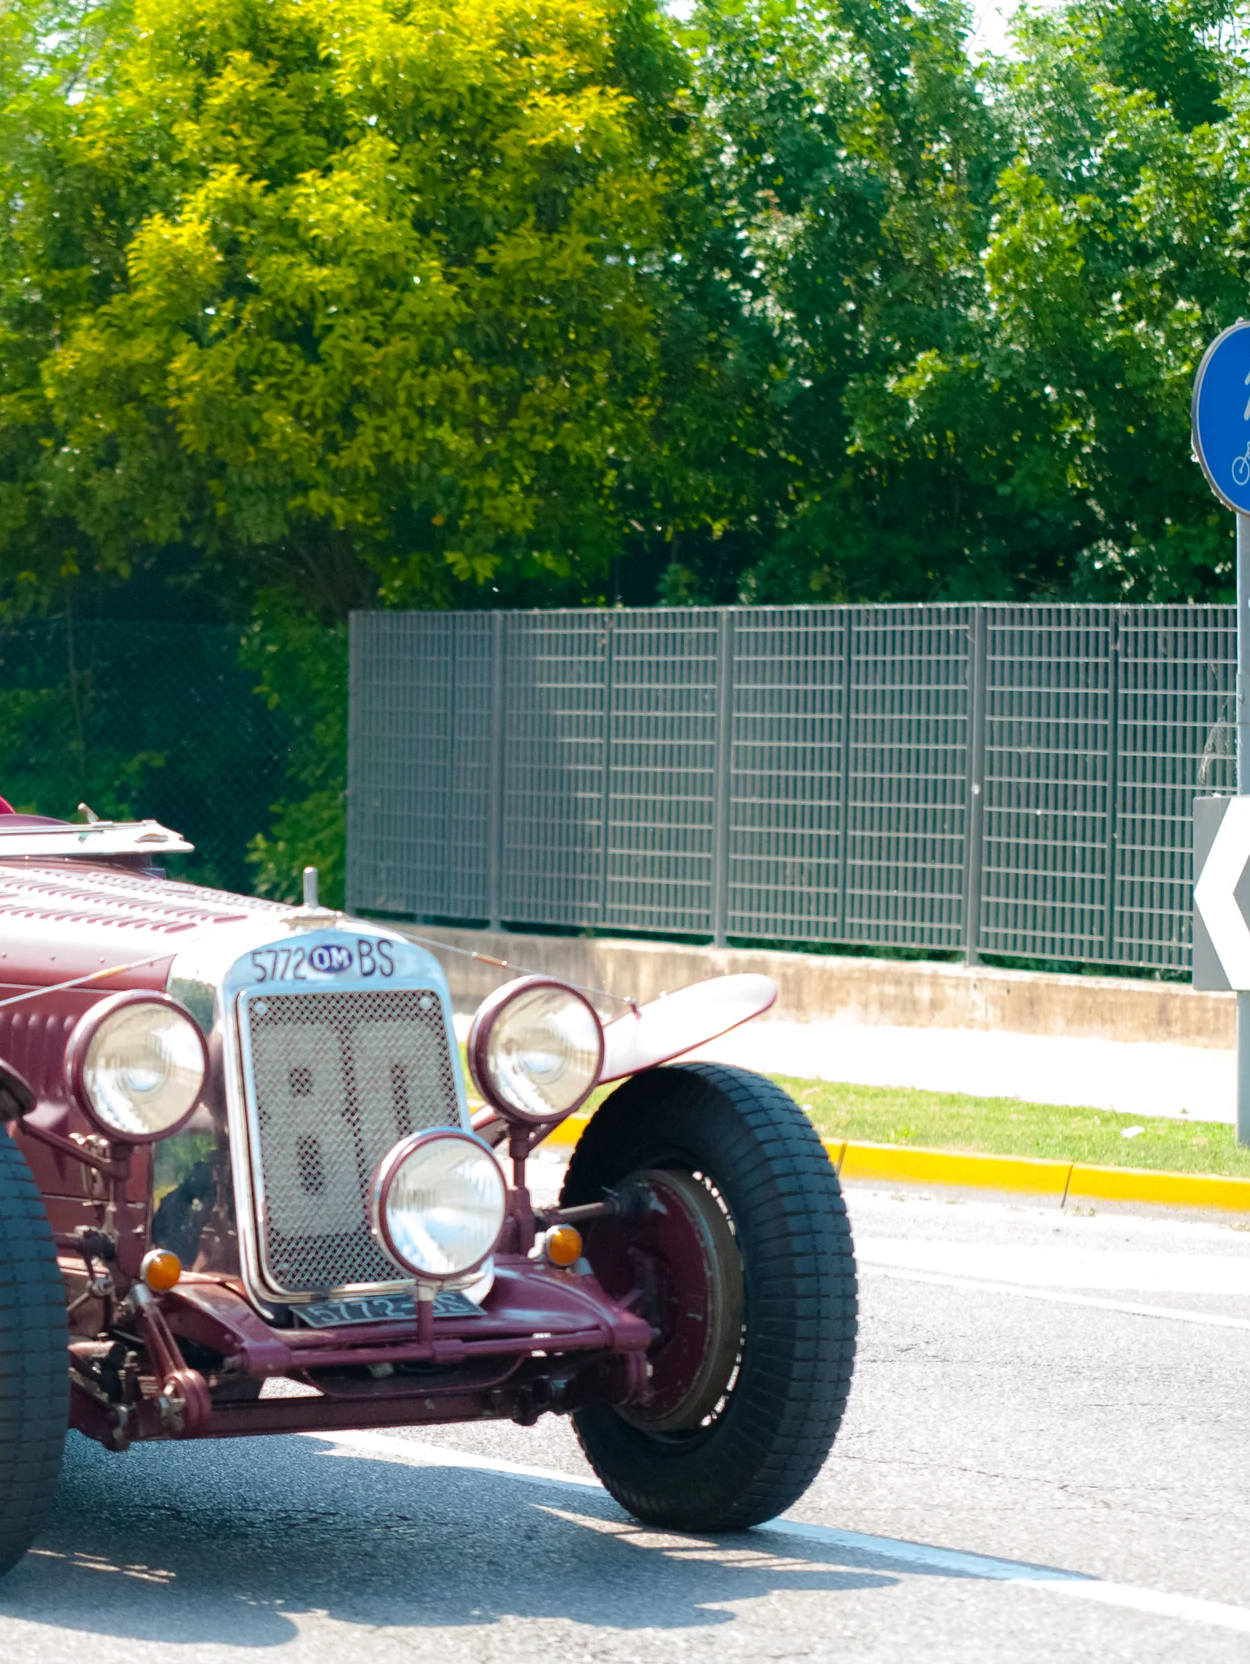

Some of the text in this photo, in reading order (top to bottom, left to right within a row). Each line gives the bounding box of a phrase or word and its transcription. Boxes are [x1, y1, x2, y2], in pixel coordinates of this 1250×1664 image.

[251, 938, 395, 983] 5772 OM BS
